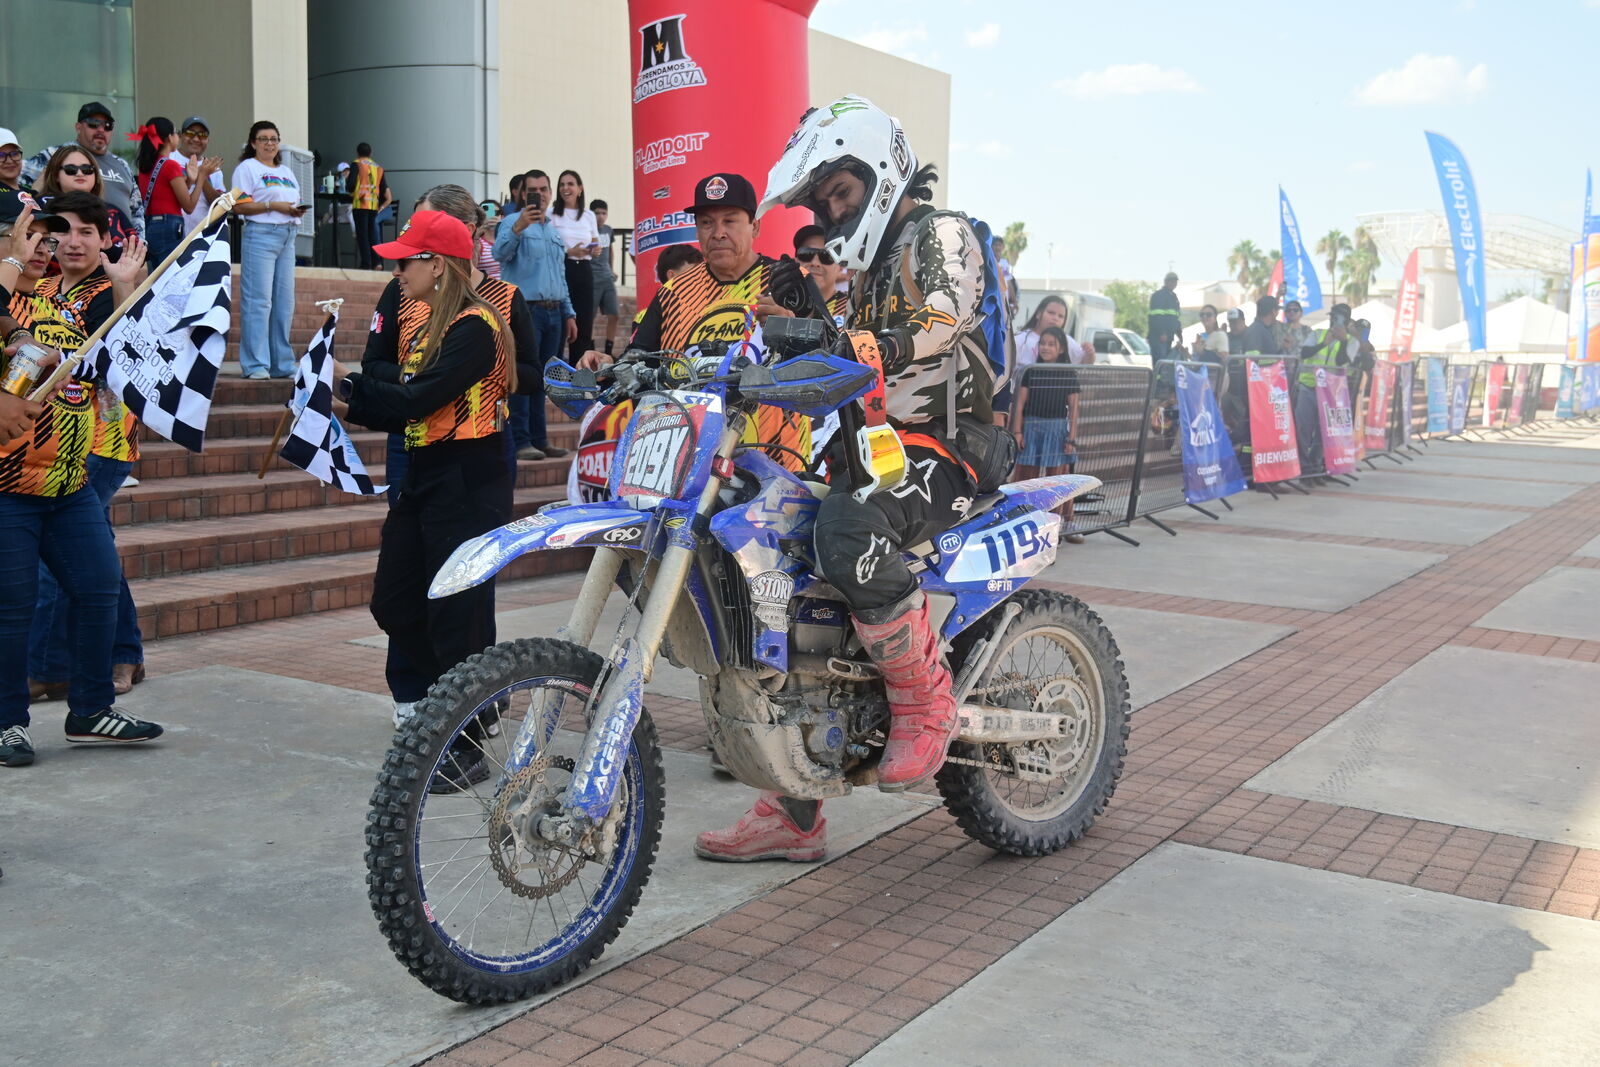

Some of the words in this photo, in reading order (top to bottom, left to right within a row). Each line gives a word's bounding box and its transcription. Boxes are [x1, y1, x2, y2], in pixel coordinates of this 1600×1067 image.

[642, 62, 686, 80] PRENDAMOS
[634, 69, 706, 101] MONCLOVA
[635, 132, 709, 169] PLAYDOIT
[1442, 160, 1477, 251] Electrolit
[636, 211, 696, 232] POLARI
[714, 318, 747, 338] AÑO
[121, 317, 162, 368] Estado
[158, 360, 174, 385] de
[109, 339, 161, 405] Coahuila
[623, 425, 690, 495] 209X
[608, 528, 638, 542] FX
[942, 536, 959, 550] FTR
[996, 580, 1013, 592] FTR
